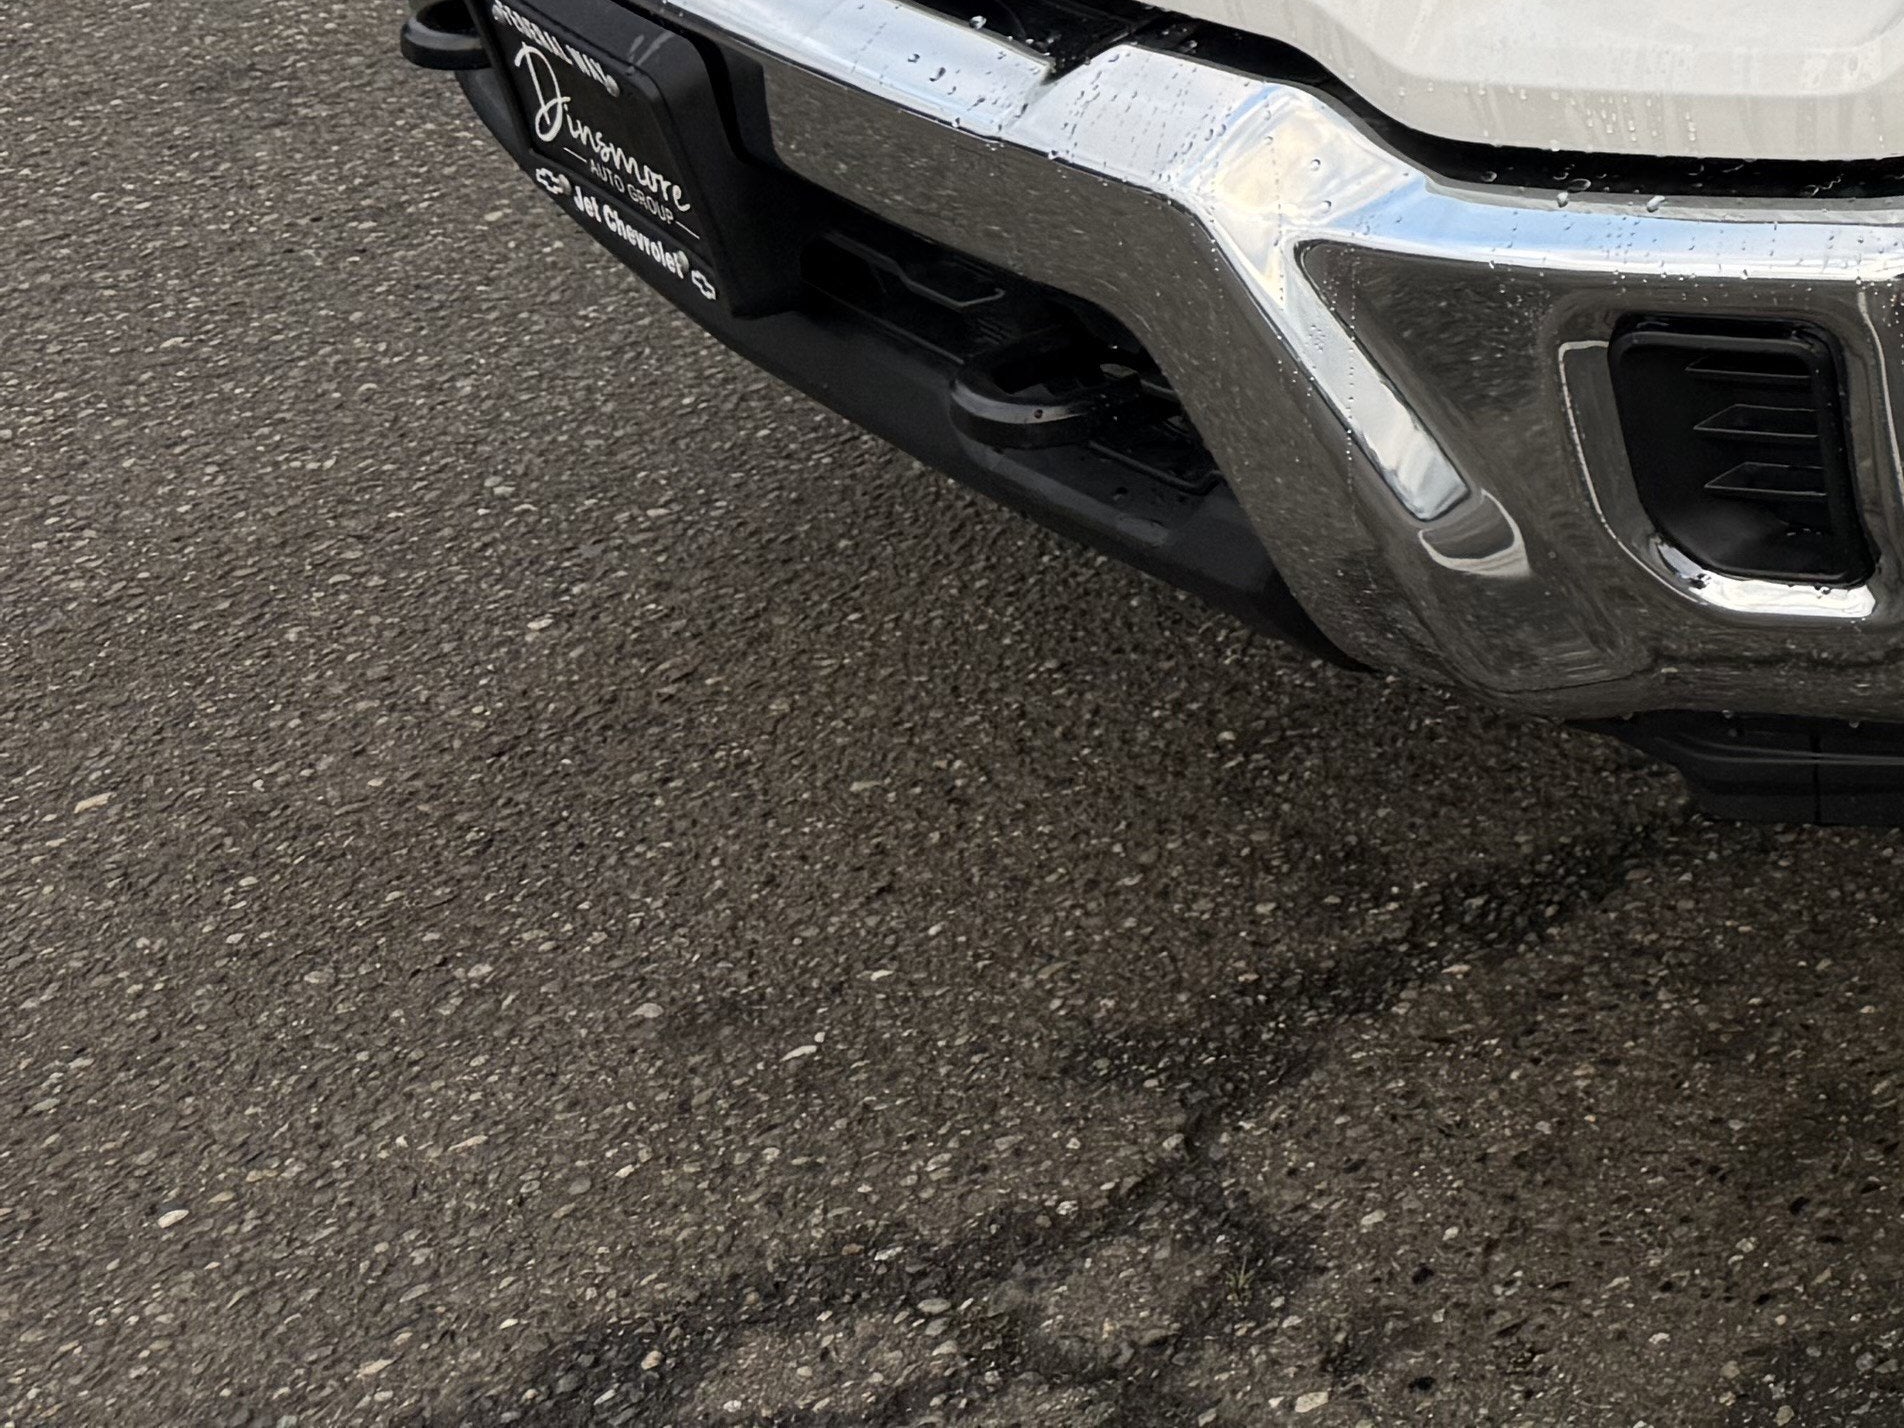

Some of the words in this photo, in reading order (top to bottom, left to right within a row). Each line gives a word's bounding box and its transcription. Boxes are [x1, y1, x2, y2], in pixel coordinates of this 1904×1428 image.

[514, 41, 691, 212] Dinsmore
[573, 185, 602, 223] Jet
[602, 204, 684, 280] Chevrolet
[590, 158, 625, 193] AUTO
[627, 183, 674, 225] GROUP
